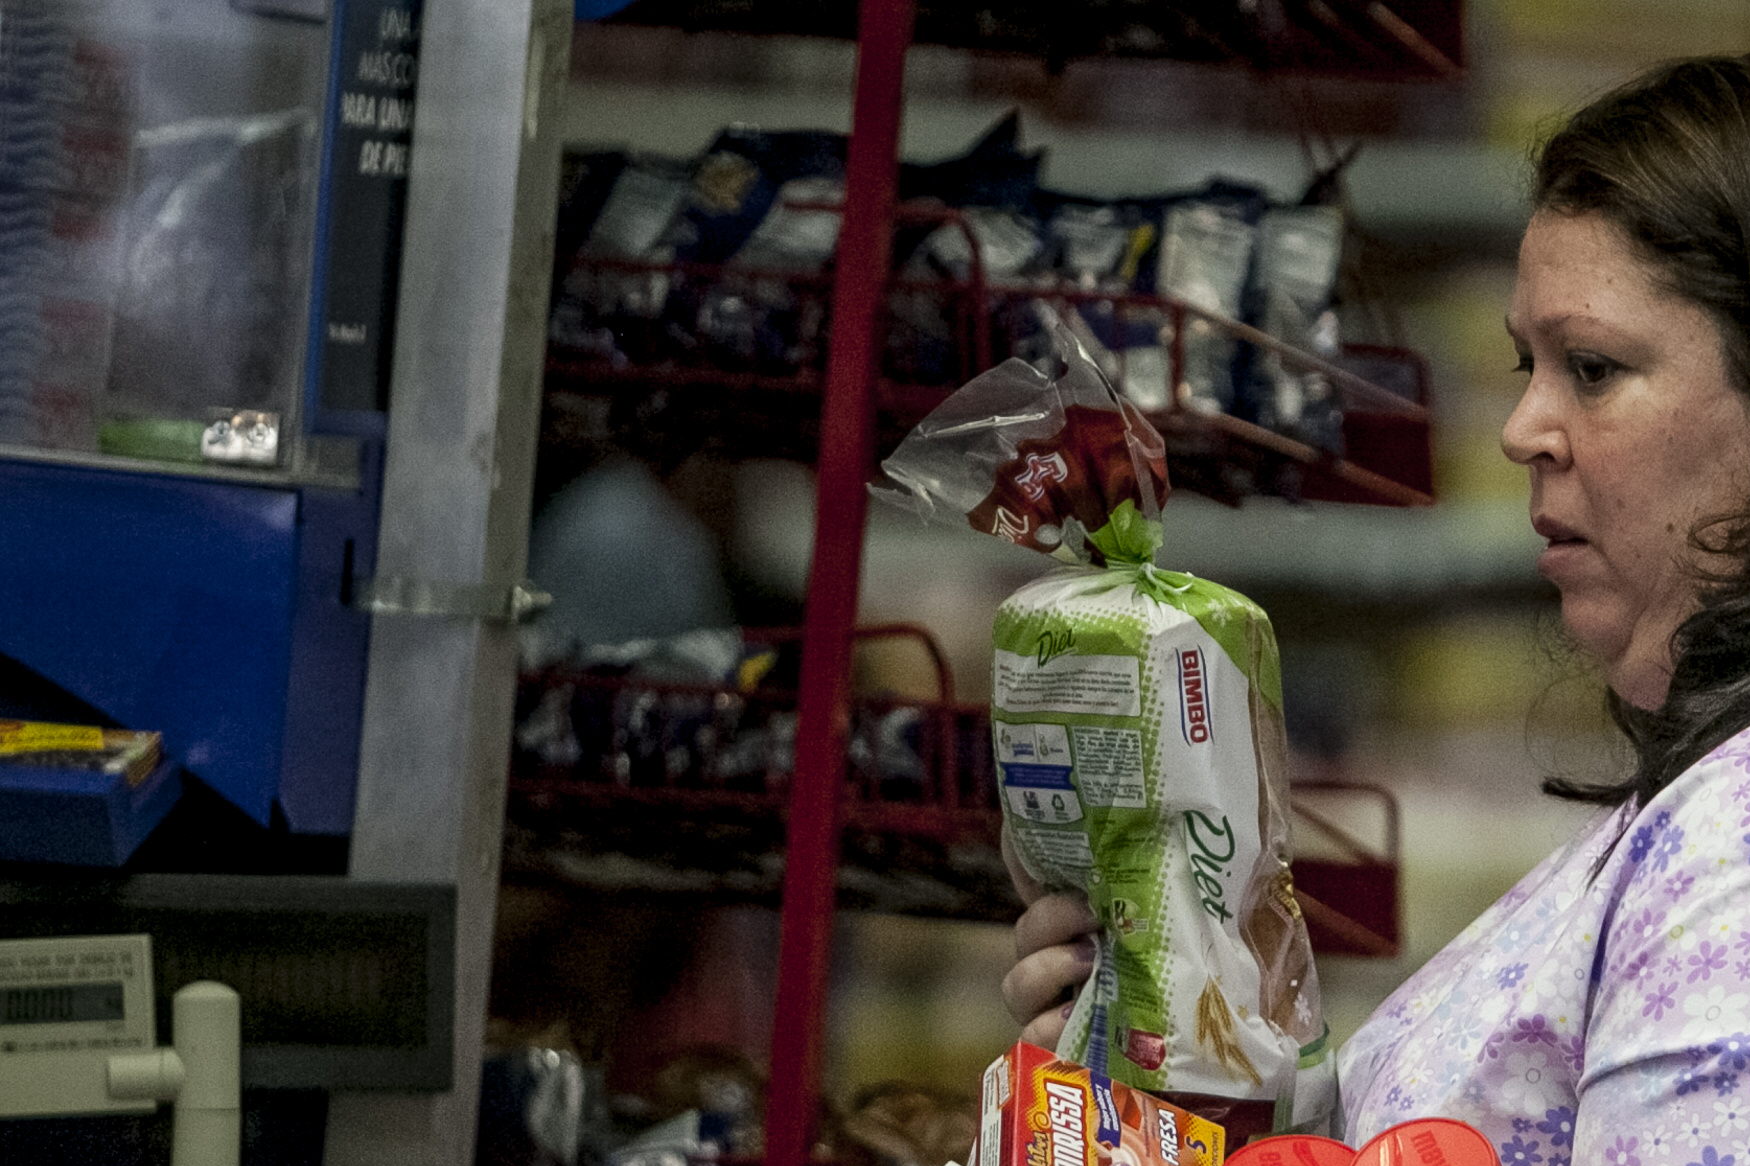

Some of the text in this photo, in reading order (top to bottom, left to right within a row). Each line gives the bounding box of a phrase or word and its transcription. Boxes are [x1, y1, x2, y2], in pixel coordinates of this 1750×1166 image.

[1037, 628, 1077, 669] Diet
[1181, 650, 1209, 744] BIMBO
[1183, 809, 1236, 924] Diet
[1158, 1108, 1179, 1166] FRESA
[1185, 1135, 1207, 1154] 5
